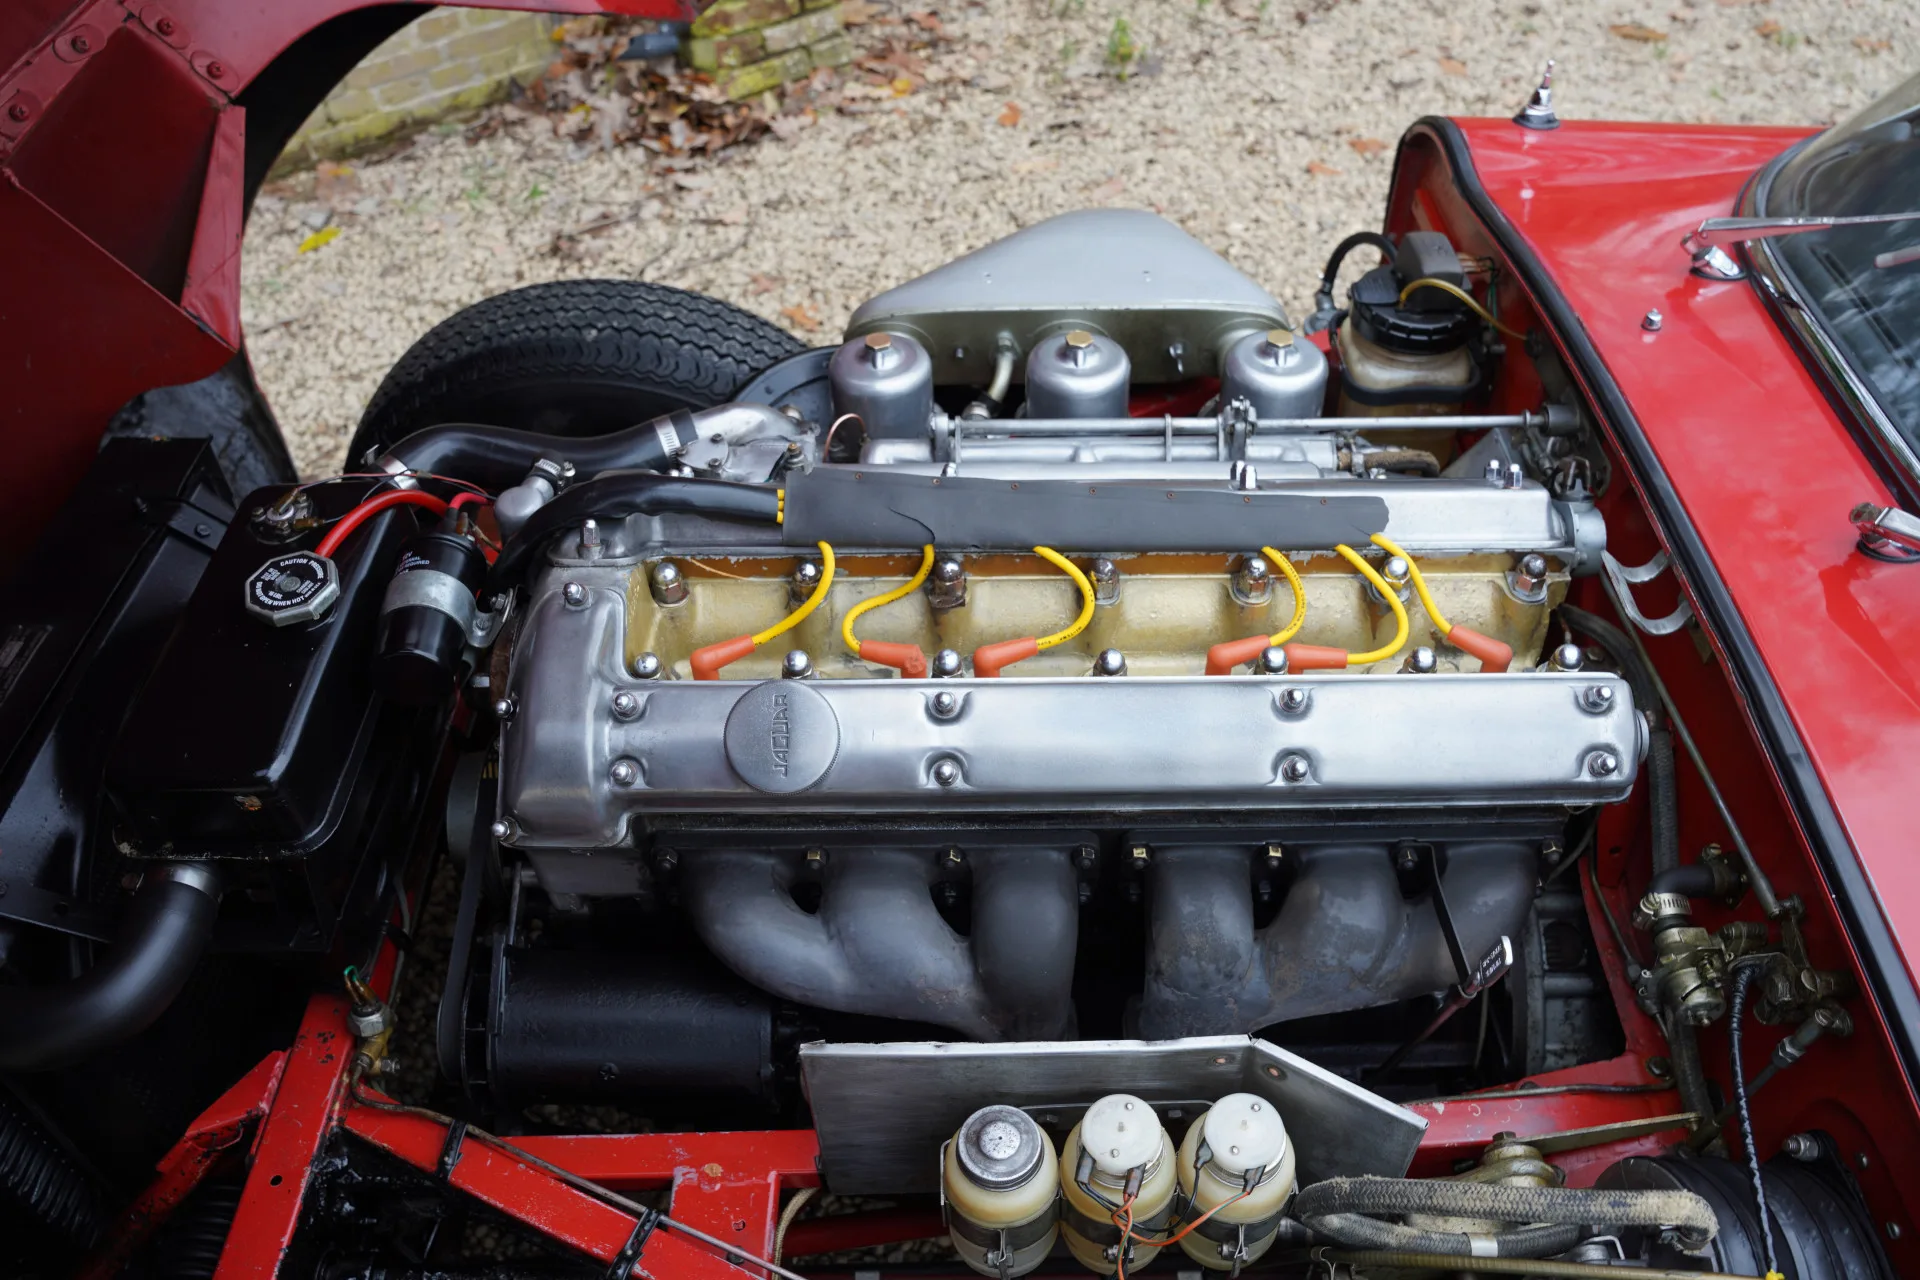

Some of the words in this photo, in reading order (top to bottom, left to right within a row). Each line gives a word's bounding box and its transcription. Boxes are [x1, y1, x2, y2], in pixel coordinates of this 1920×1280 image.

[280, 558, 308, 566] CAUTION
[292, 596, 304, 604] HOT
[771, 693, 789, 779] JAGUAR
